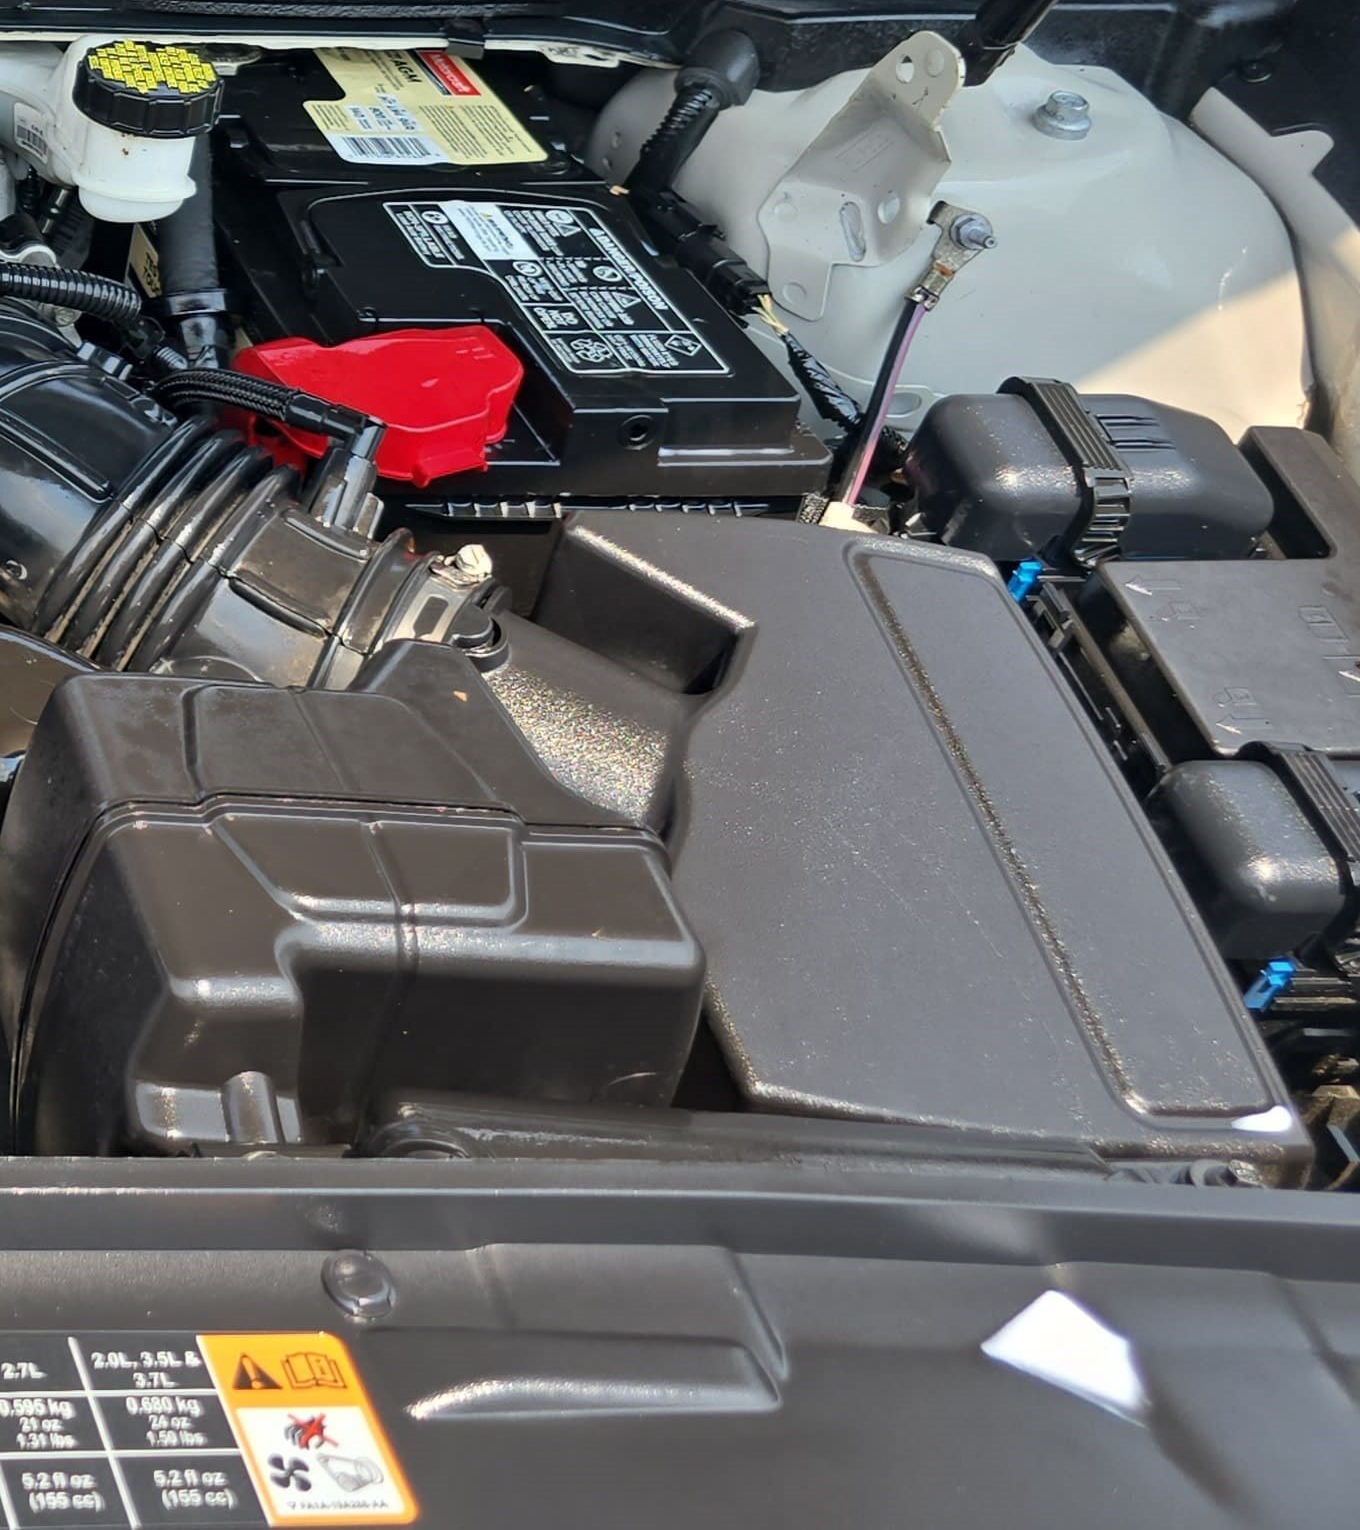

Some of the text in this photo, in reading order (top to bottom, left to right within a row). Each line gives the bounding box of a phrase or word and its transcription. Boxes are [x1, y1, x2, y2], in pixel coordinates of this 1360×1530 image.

[547, 309, 568, 326] NOT
[560, 312, 579, 325] DO
[91, 1351, 202, 1369] 2.0L, 3.5L &
[1, 1362, 48, 1379] 2.7L
[132, 1371, 181, 1388] 3.7L
[47, 1398, 77, 1419] kg
[176, 1396, 205, 1418] kg
[18, 1417, 66, 1431] 21 oz
[148, 1415, 195, 1430] 24 oz
[50, 1432, 79, 1449] lbs
[180, 1429, 209, 1447] lbs
[21, 1472, 97, 1490] 5.2 fl oz
[153, 1469, 229, 1487] 5.2 fl oz
[28, 1491, 106, 1514] (155 cc)
[161, 1488, 239, 1510] (155 cc)
